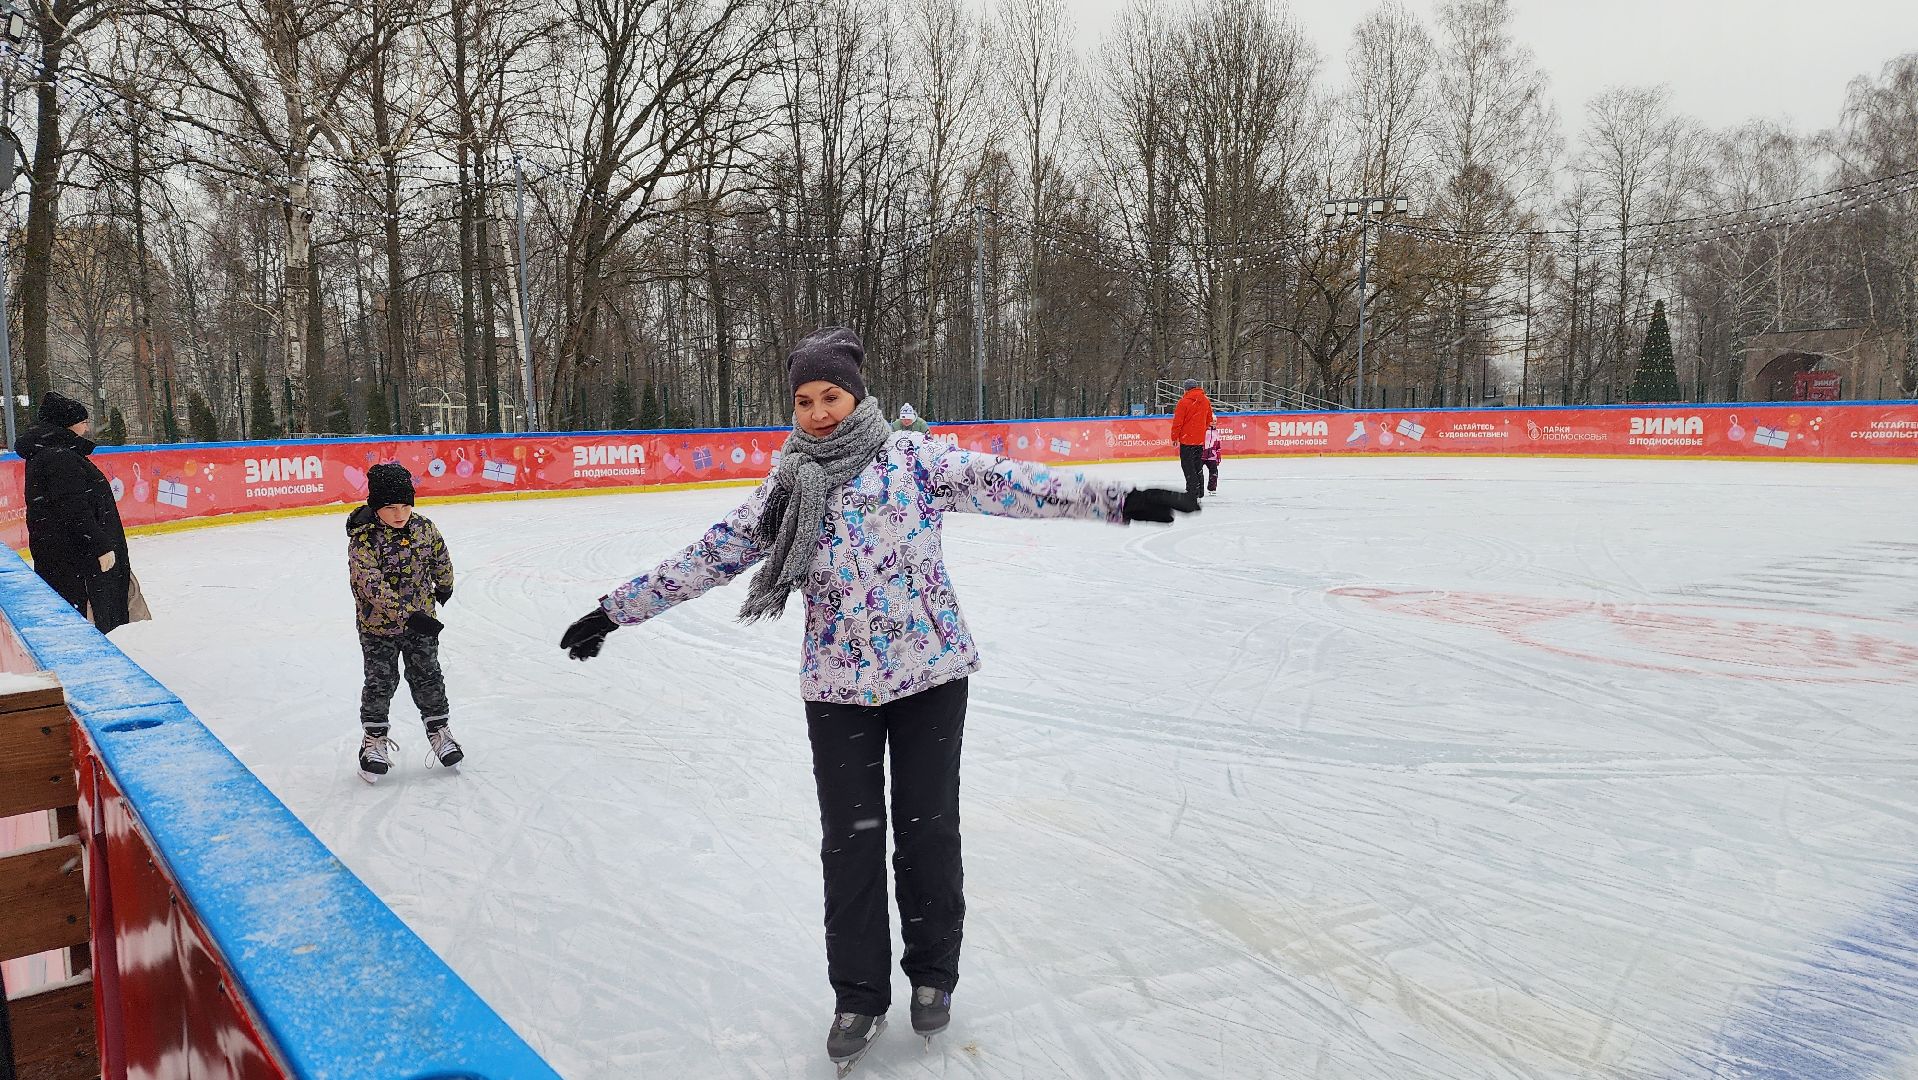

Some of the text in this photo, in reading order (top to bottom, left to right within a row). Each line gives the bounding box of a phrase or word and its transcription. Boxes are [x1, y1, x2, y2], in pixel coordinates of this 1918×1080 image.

[1267, 420, 1329, 437] ЗИМА
[1453, 422, 1495, 430] КАТАЙТЕСЬ
[1630, 416, 1704, 435] ЗИМА
[1870, 421, 1918, 429] КАТАЙТЕ
[1118, 432, 1141, 440] ПАРКИ
[1445, 431, 1509, 439] УДОВОЛЬСТВИЕМ!
[1542, 433, 1608, 441] ПОДМОСКОВЬЯ
[1274, 438, 1328, 447] ПОДМОСКОВЬЕ
[1636, 437, 1703, 446] ПОДМОСКОВЬЕ
[572, 444, 645, 467] ЗИМА
[244, 455, 323, 484] ЗИМА
[574, 467, 646, 478] В ПОДМОСКОВЬЕ
[246, 484, 325, 498] В ПОДМОСКОВЬЕ
